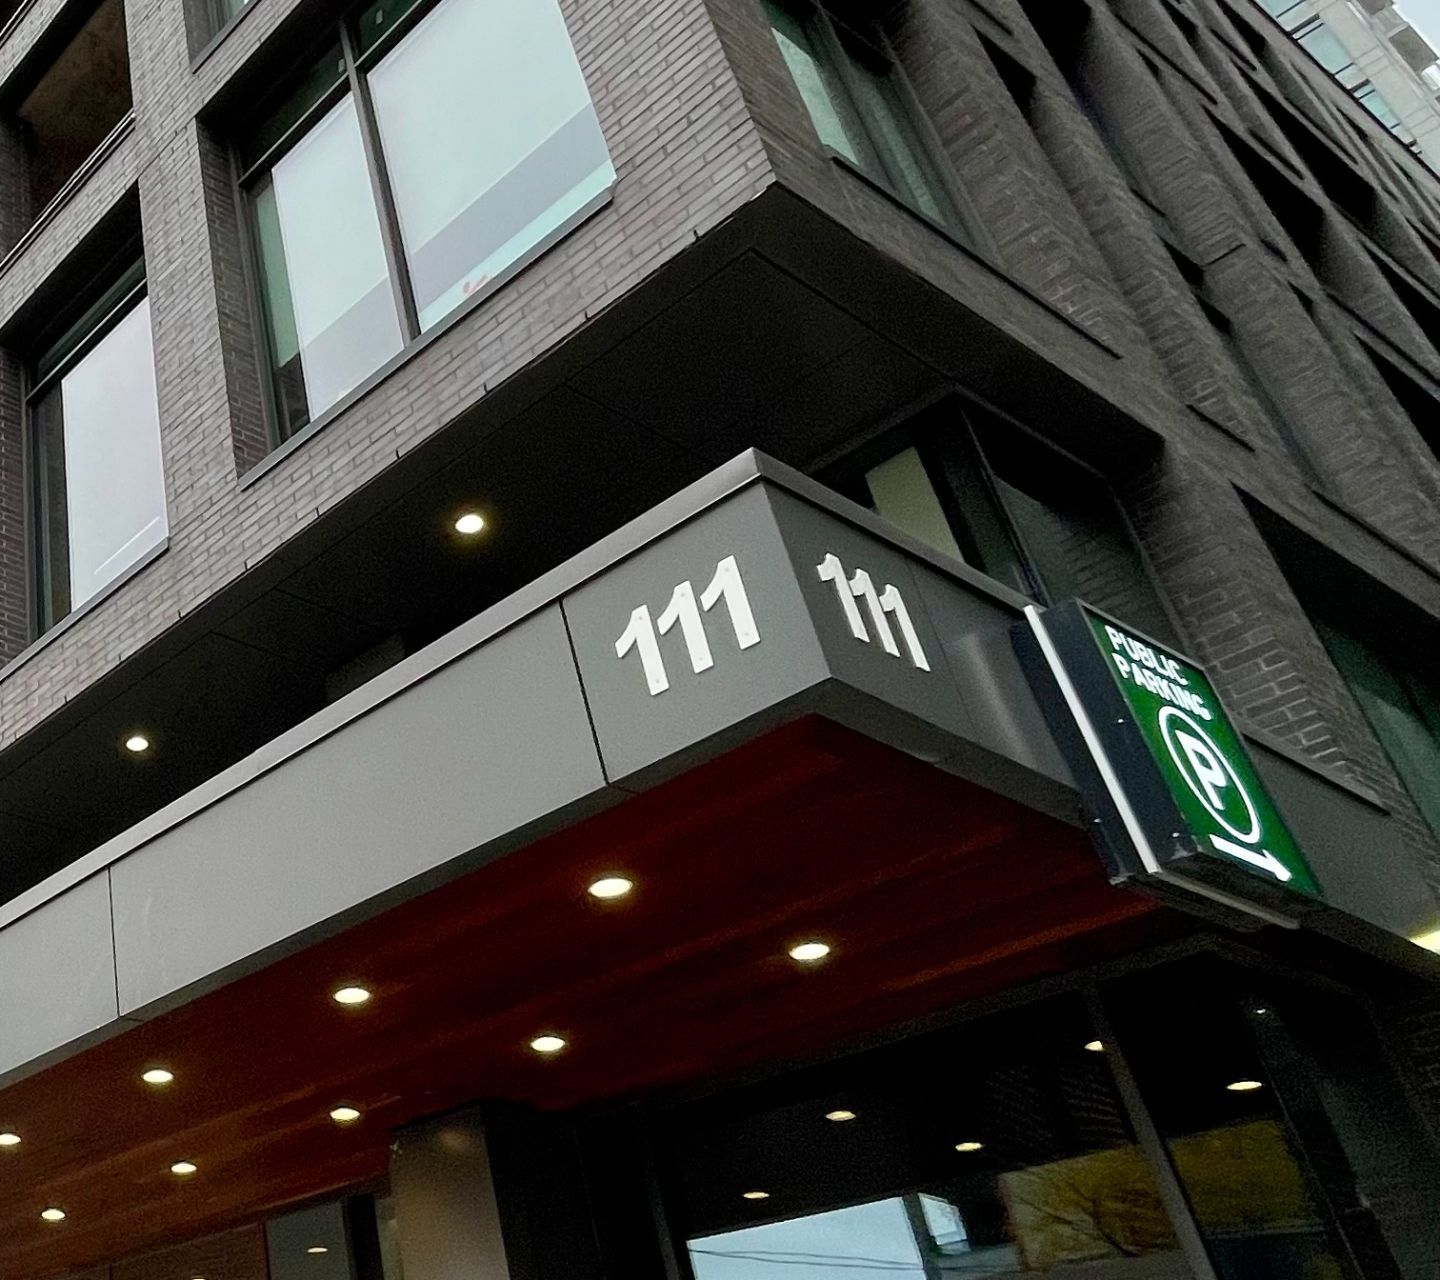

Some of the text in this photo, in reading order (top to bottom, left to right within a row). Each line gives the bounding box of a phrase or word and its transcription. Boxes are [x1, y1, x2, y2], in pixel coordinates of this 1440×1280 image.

[615, 554, 761, 697] 111
[816, 552, 931, 673] 111
[1105, 625, 1189, 686] PUBLIC
[1111, 652, 1212, 721] PARKING
